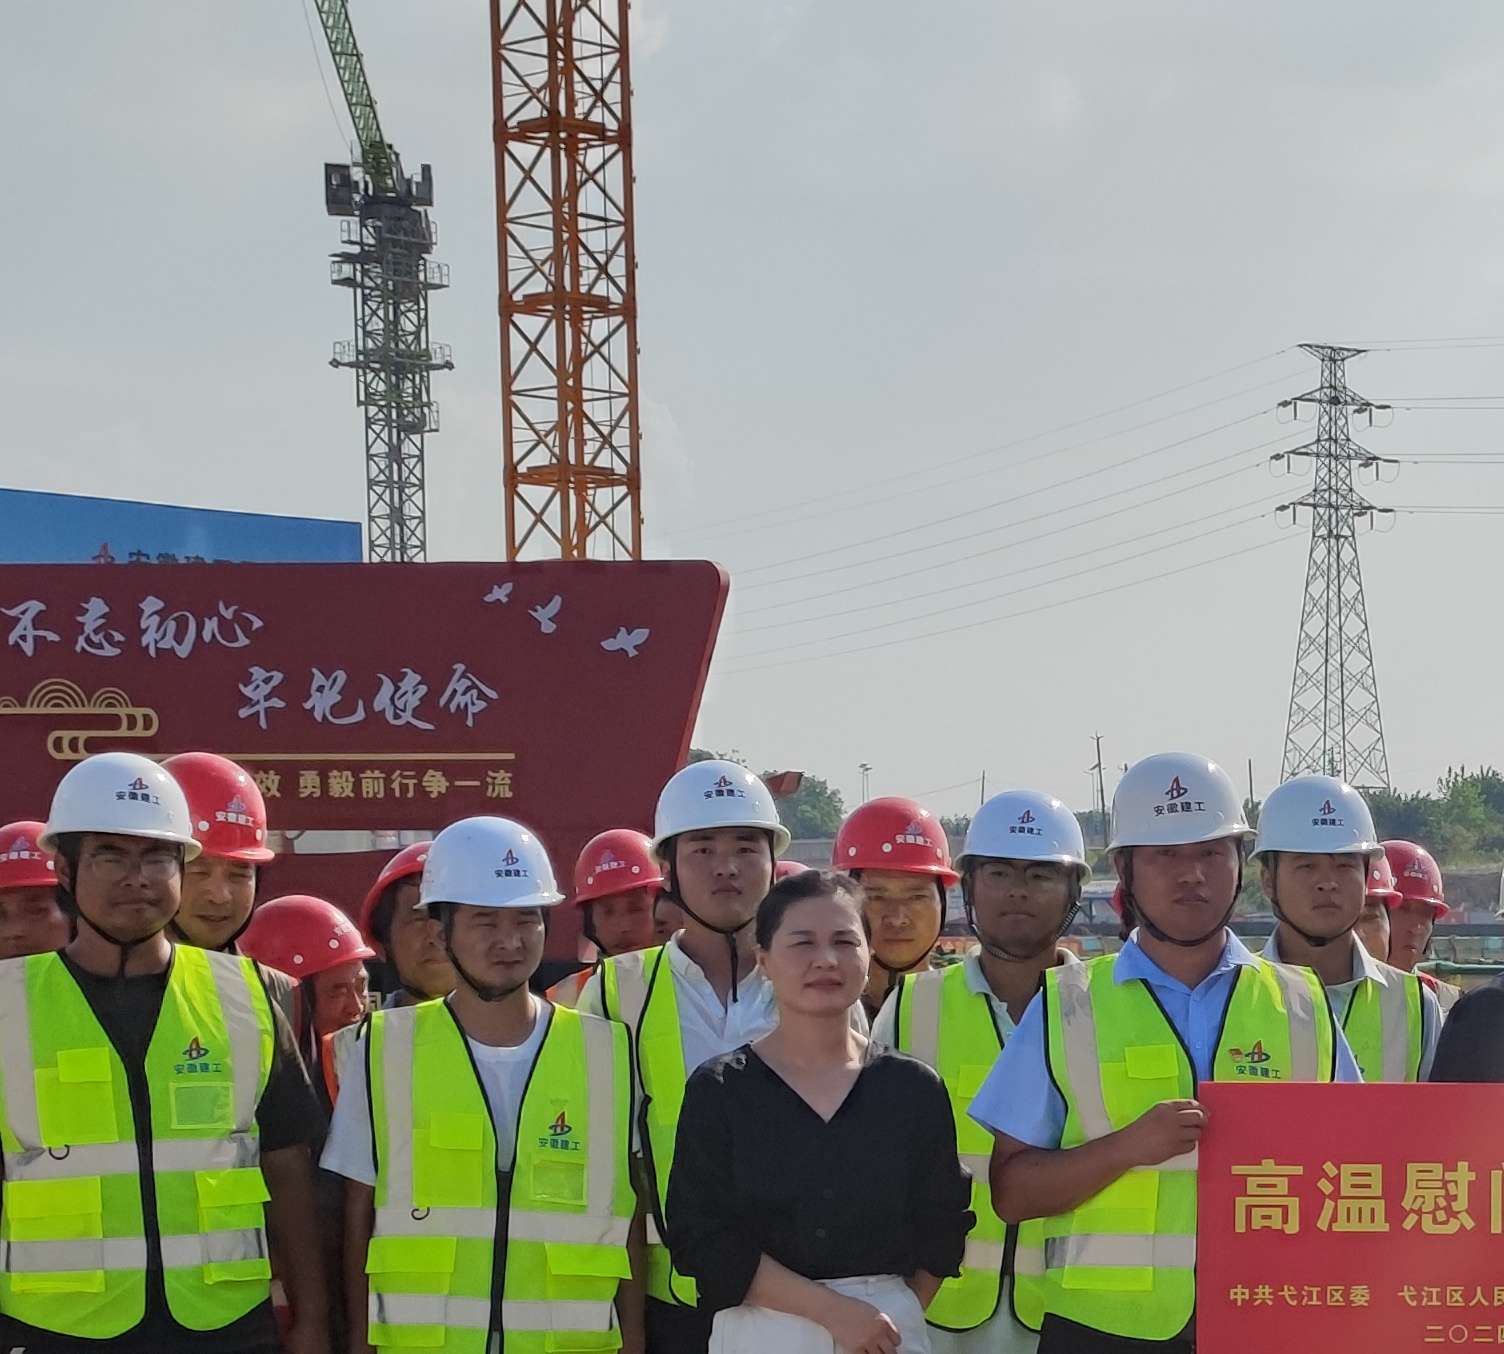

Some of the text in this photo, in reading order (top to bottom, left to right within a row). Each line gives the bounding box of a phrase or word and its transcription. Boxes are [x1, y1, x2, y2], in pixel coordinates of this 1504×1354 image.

[0, 596, 264, 659] 不忘初心
[237, 662, 499, 731] 牢记使命
[298, 769, 514, 800] 勇毅前行争一流
[703, 788, 746, 799] 安徽建工
[1153, 799, 1207, 817] 安徽建工
[1311, 817, 1345, 828] 安徽建工
[1009, 825, 1044, 837] 安徽建工
[494, 868, 530, 879] 安徽建工
[1235, 1064, 1282, 1080] 安徽建工
[538, 1137, 581, 1151] 安徽建工
[1230, 1284, 1371, 1307] 中共弋江区委
